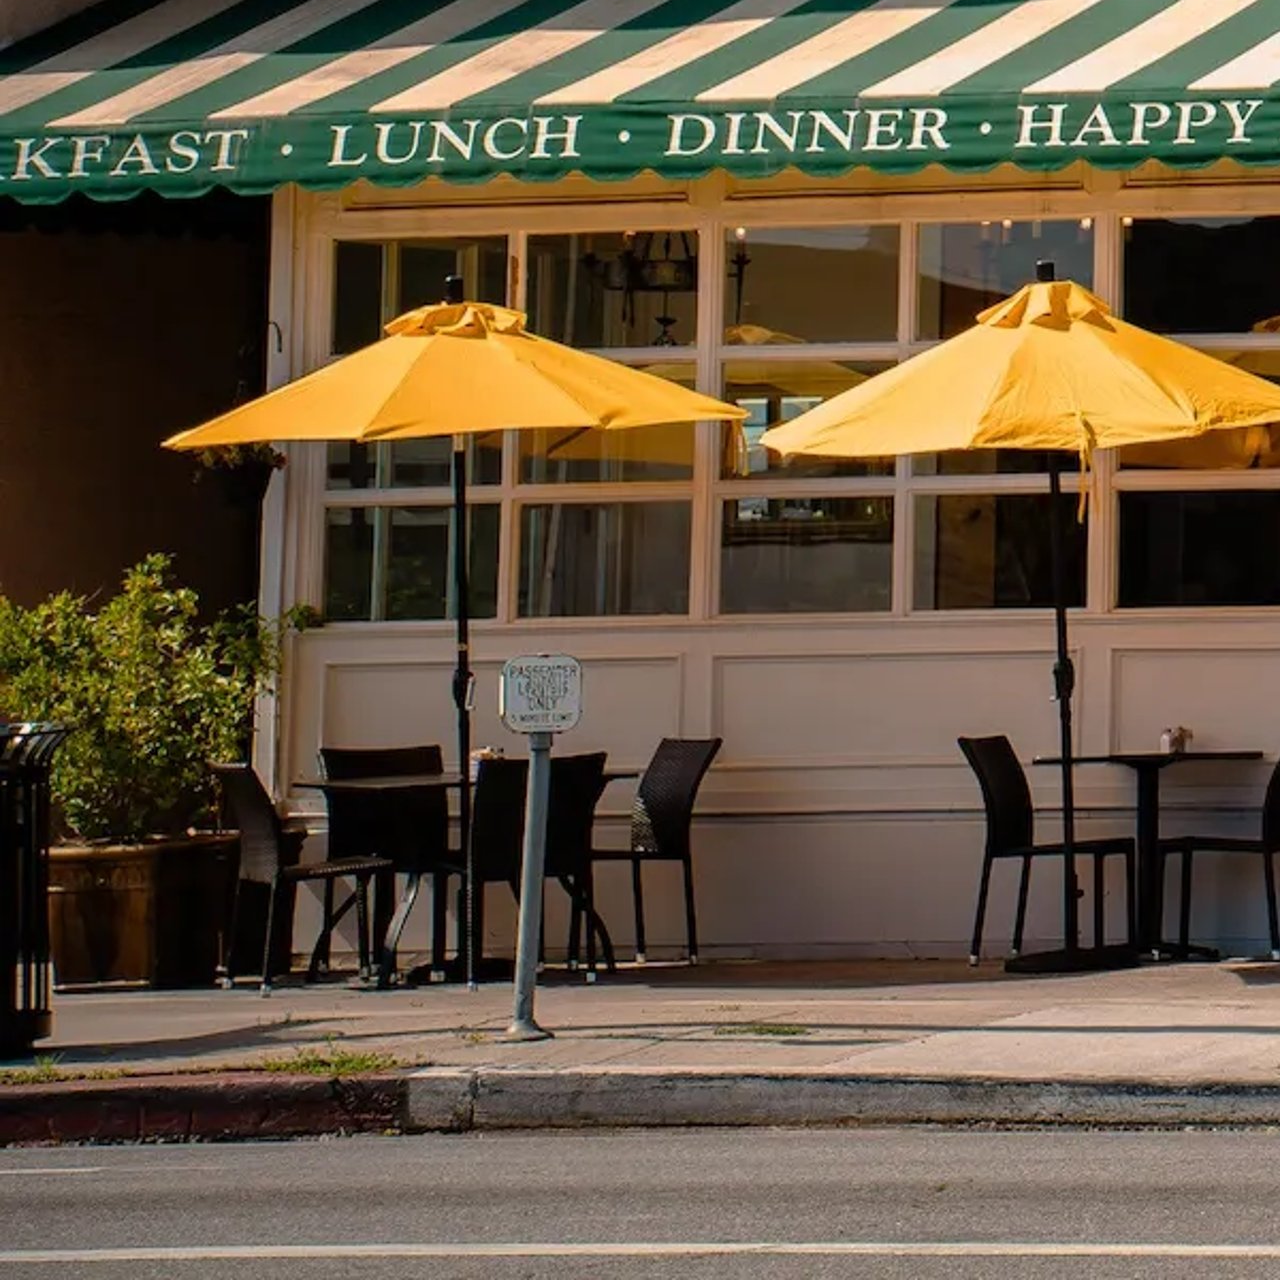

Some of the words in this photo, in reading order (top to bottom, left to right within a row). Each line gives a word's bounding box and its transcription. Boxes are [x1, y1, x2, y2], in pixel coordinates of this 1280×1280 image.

[0, 128, 249, 181] KFAST
[327, 114, 584, 167] LUNCH
[664, 107, 951, 158] DINNER
[1014, 99, 1264, 149] HAPPY
